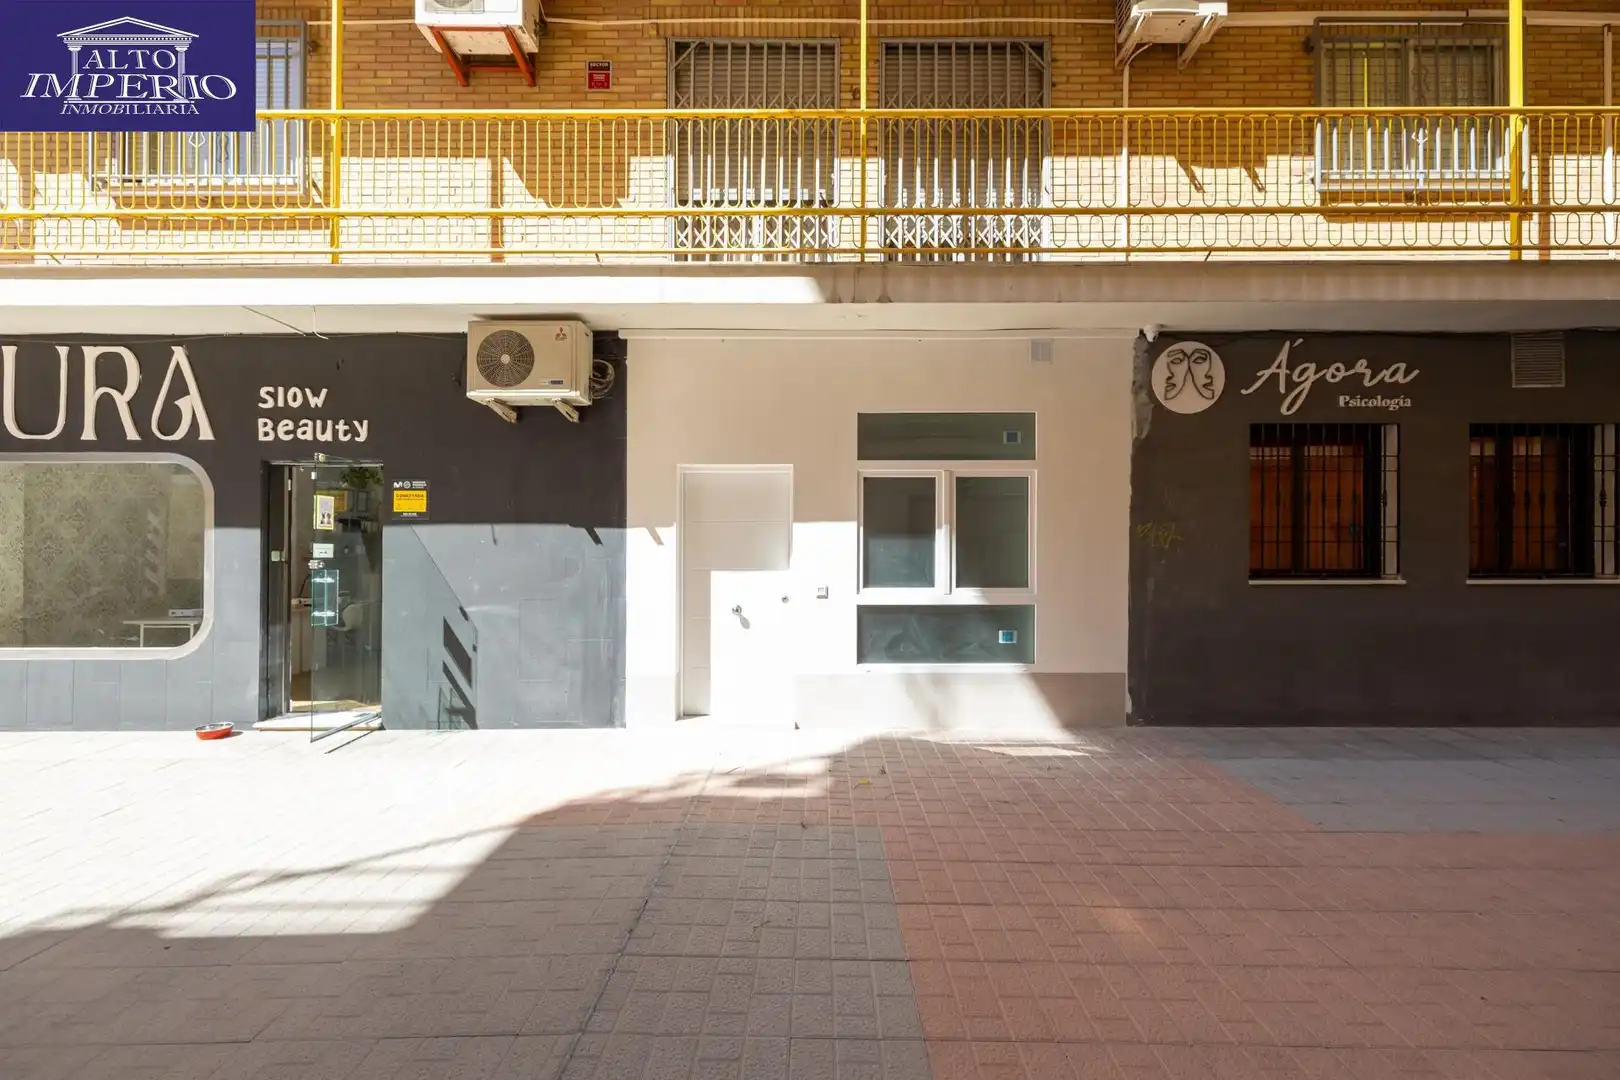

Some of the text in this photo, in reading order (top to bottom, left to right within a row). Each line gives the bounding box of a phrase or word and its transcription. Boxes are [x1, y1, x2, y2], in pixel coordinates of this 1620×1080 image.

[1, 345, 215, 441] URA
[1240, 338, 1420, 416] Ágora
[1338, 394, 1412, 411] Psicología
[257, 417, 369, 442] Beauty
